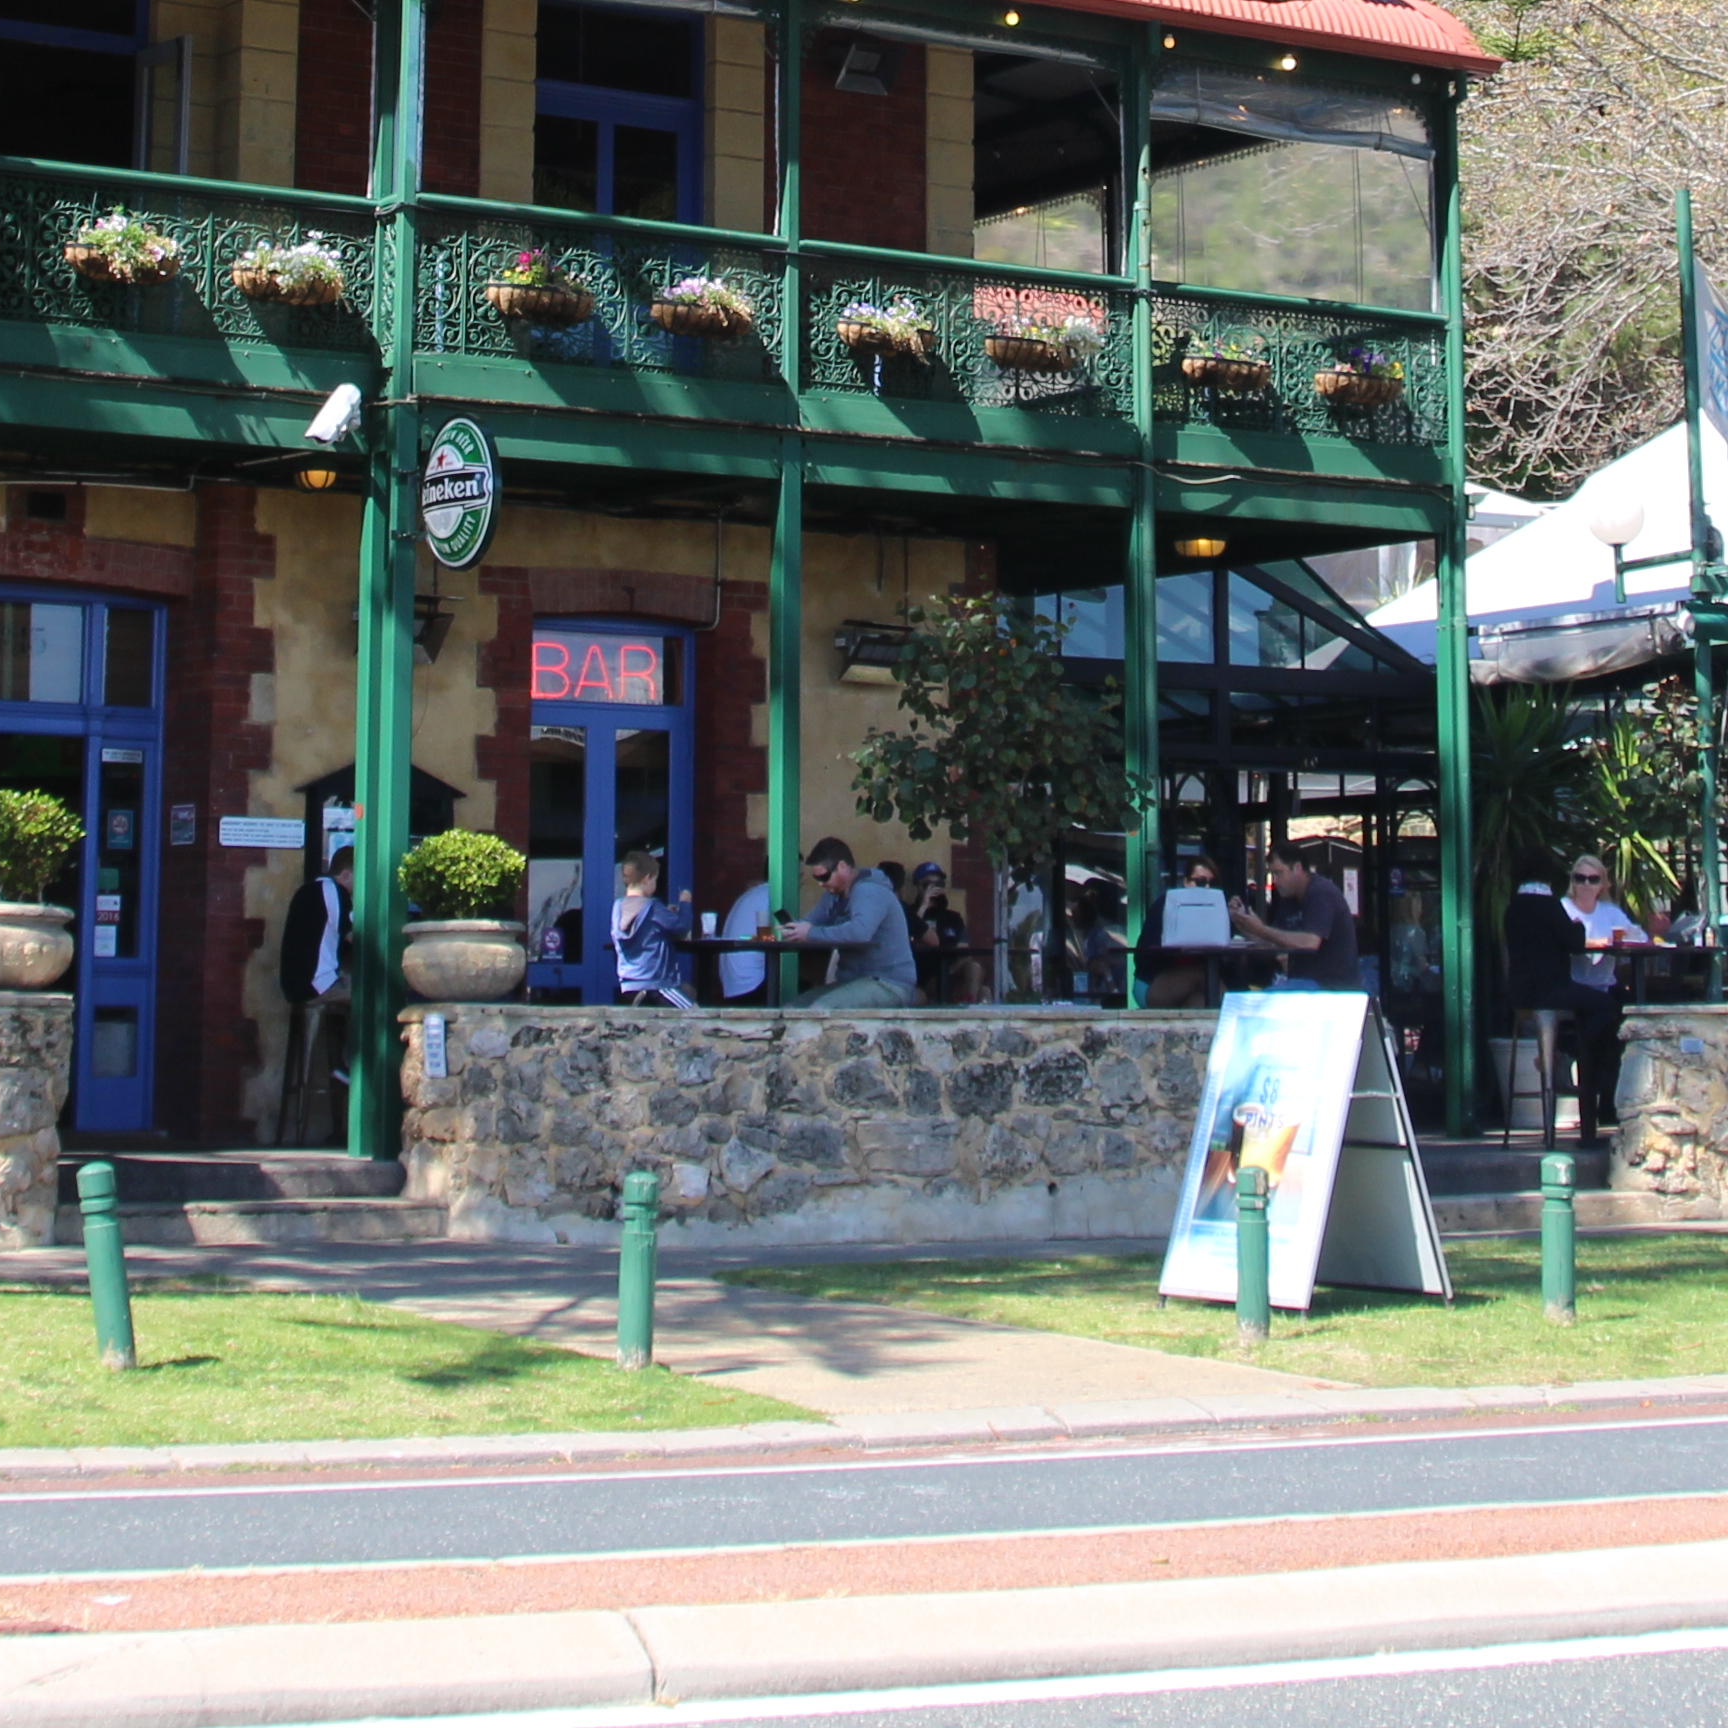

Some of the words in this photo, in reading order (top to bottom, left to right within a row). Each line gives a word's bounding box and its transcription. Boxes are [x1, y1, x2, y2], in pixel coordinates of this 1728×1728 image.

[422, 477, 480, 507] eineken
[530, 641, 658, 700] BAR
[1244, 1112, 1284, 1129] PINTS
